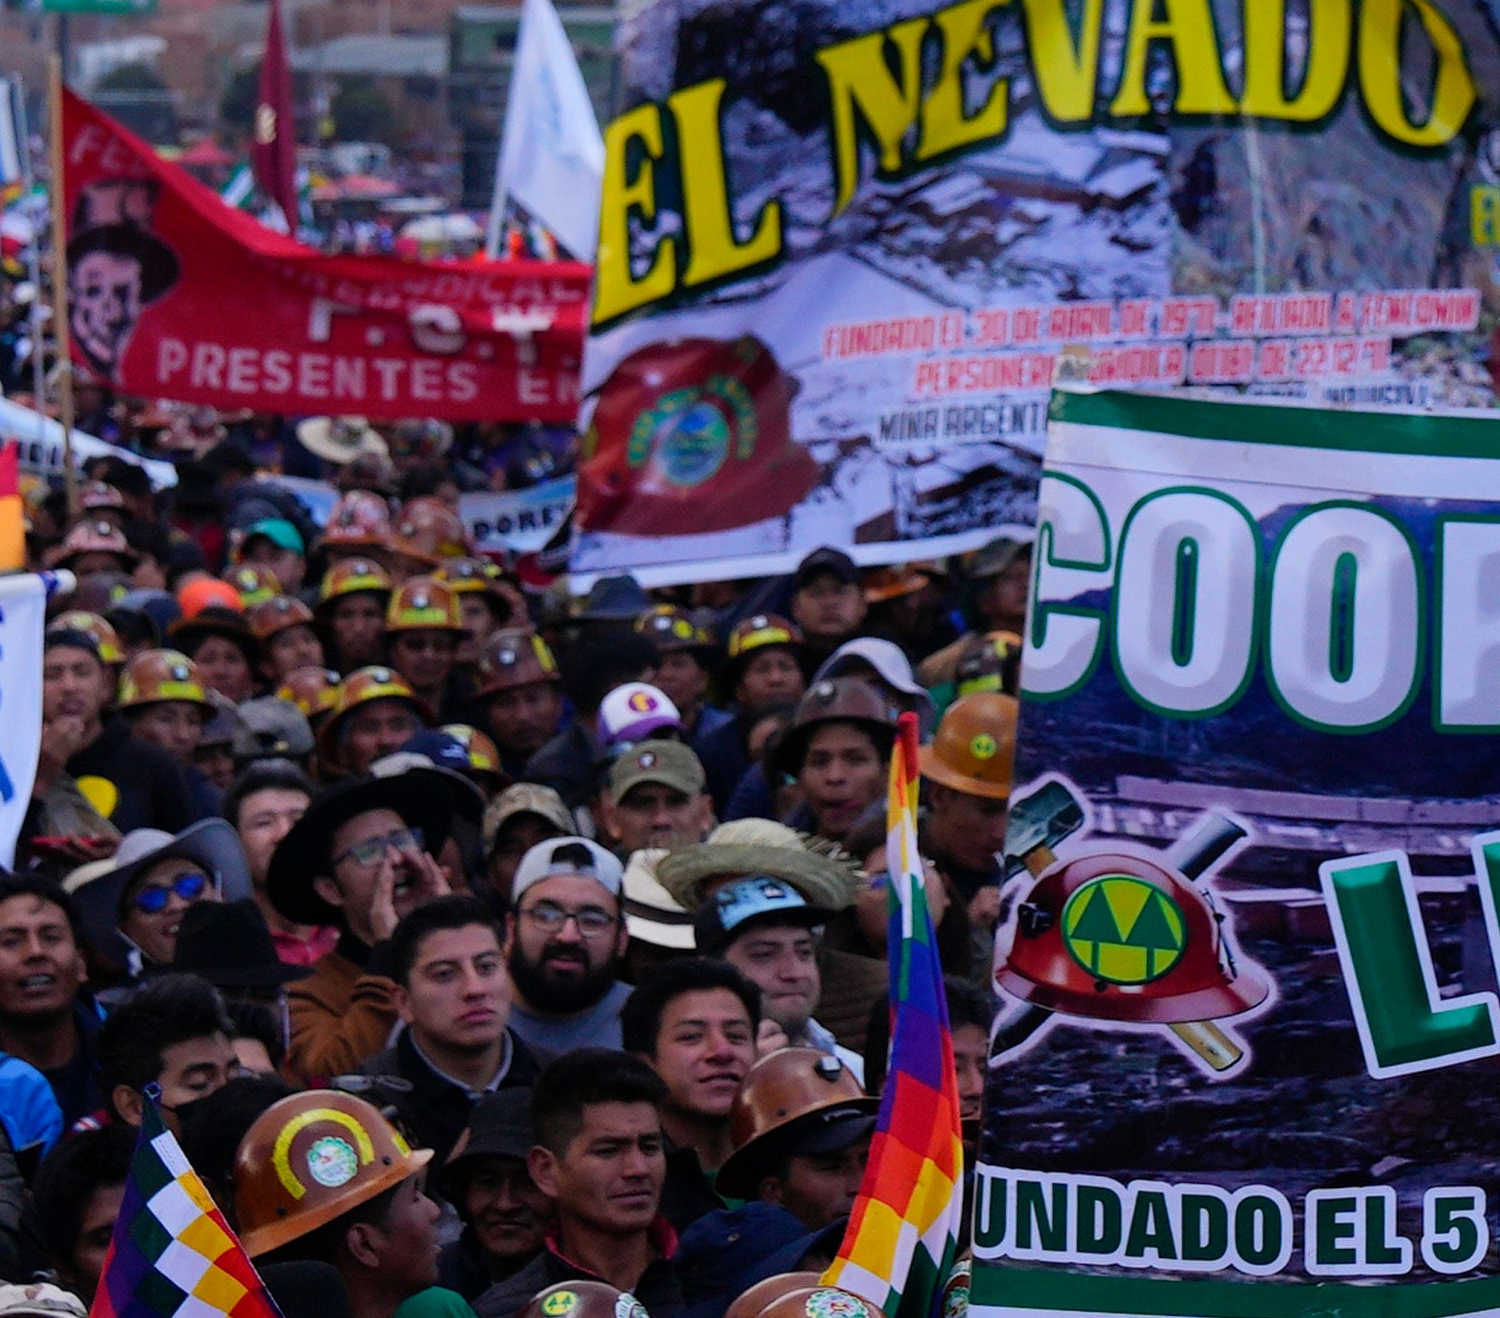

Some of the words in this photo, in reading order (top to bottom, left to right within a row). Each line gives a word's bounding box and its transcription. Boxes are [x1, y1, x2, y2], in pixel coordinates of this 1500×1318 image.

[591, 81, 781, 329] EL
[156, 337, 478, 403] PRESENTES
[915, 354, 1054, 393] PERSONERI
[1313, 1180, 1414, 1276] EL
[1422, 1180, 1488, 1276] 5
